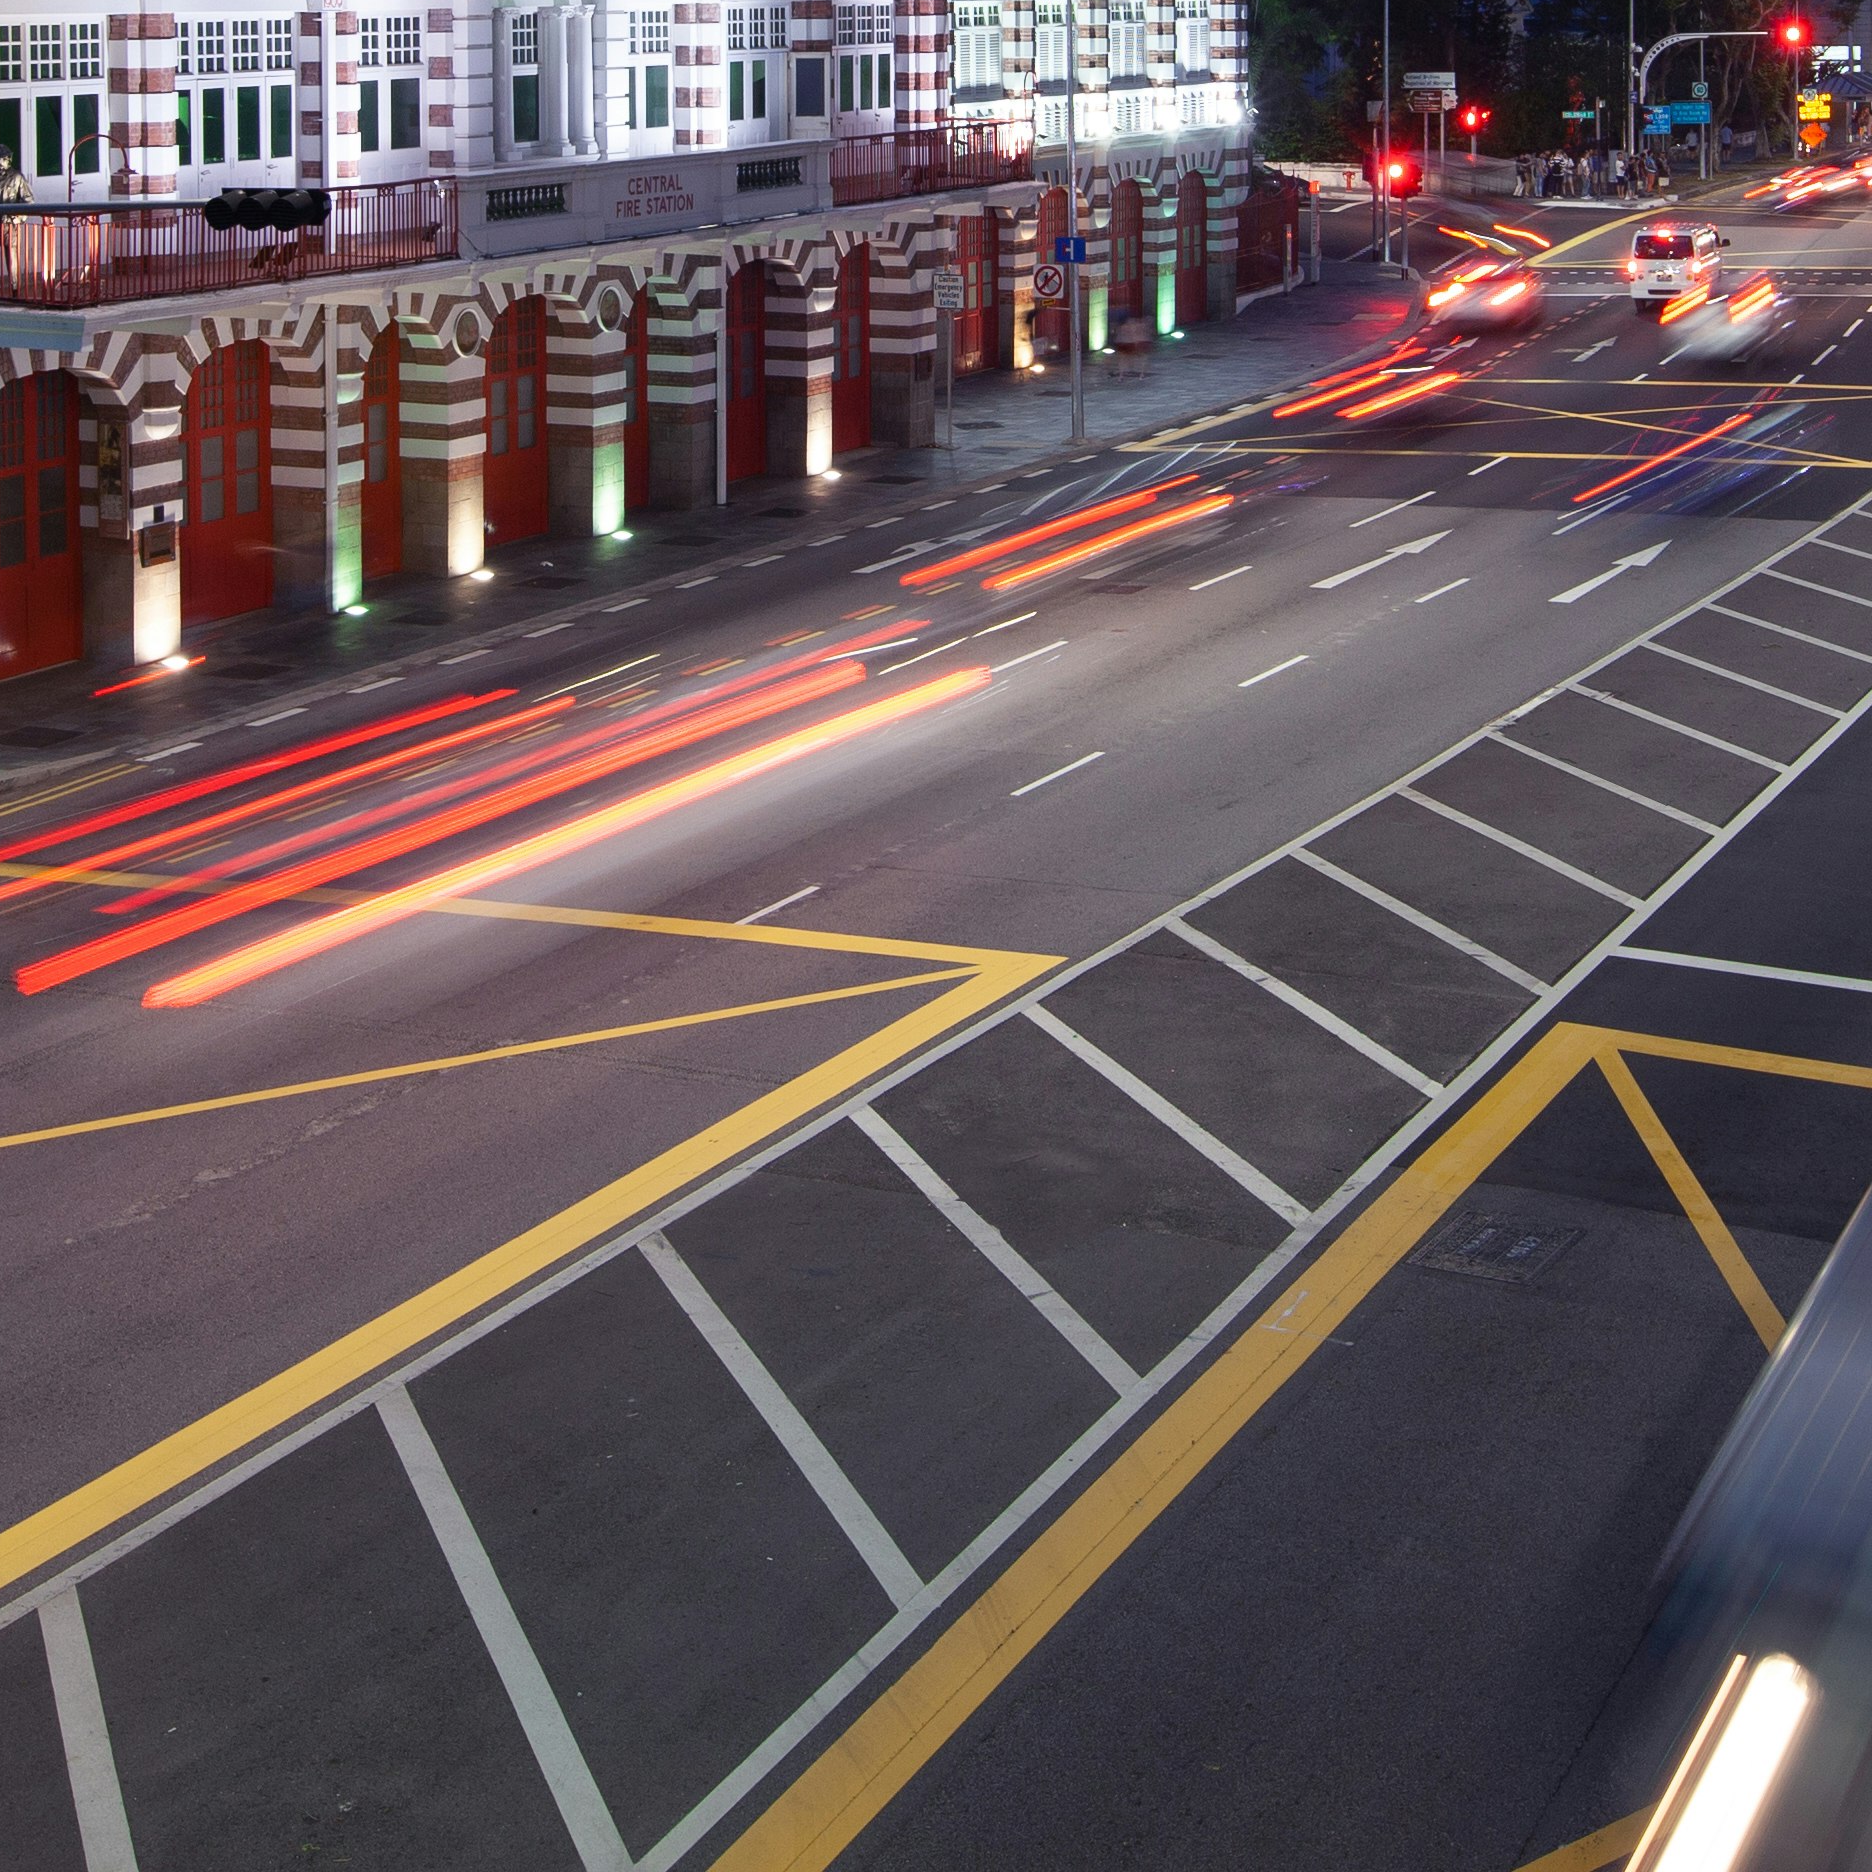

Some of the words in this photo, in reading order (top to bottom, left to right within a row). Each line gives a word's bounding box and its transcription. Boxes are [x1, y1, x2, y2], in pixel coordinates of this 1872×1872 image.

[628, 174, 683, 195] CENTRAL
[616, 199, 641, 218] FIRE
[646, 193, 694, 215] STATION
